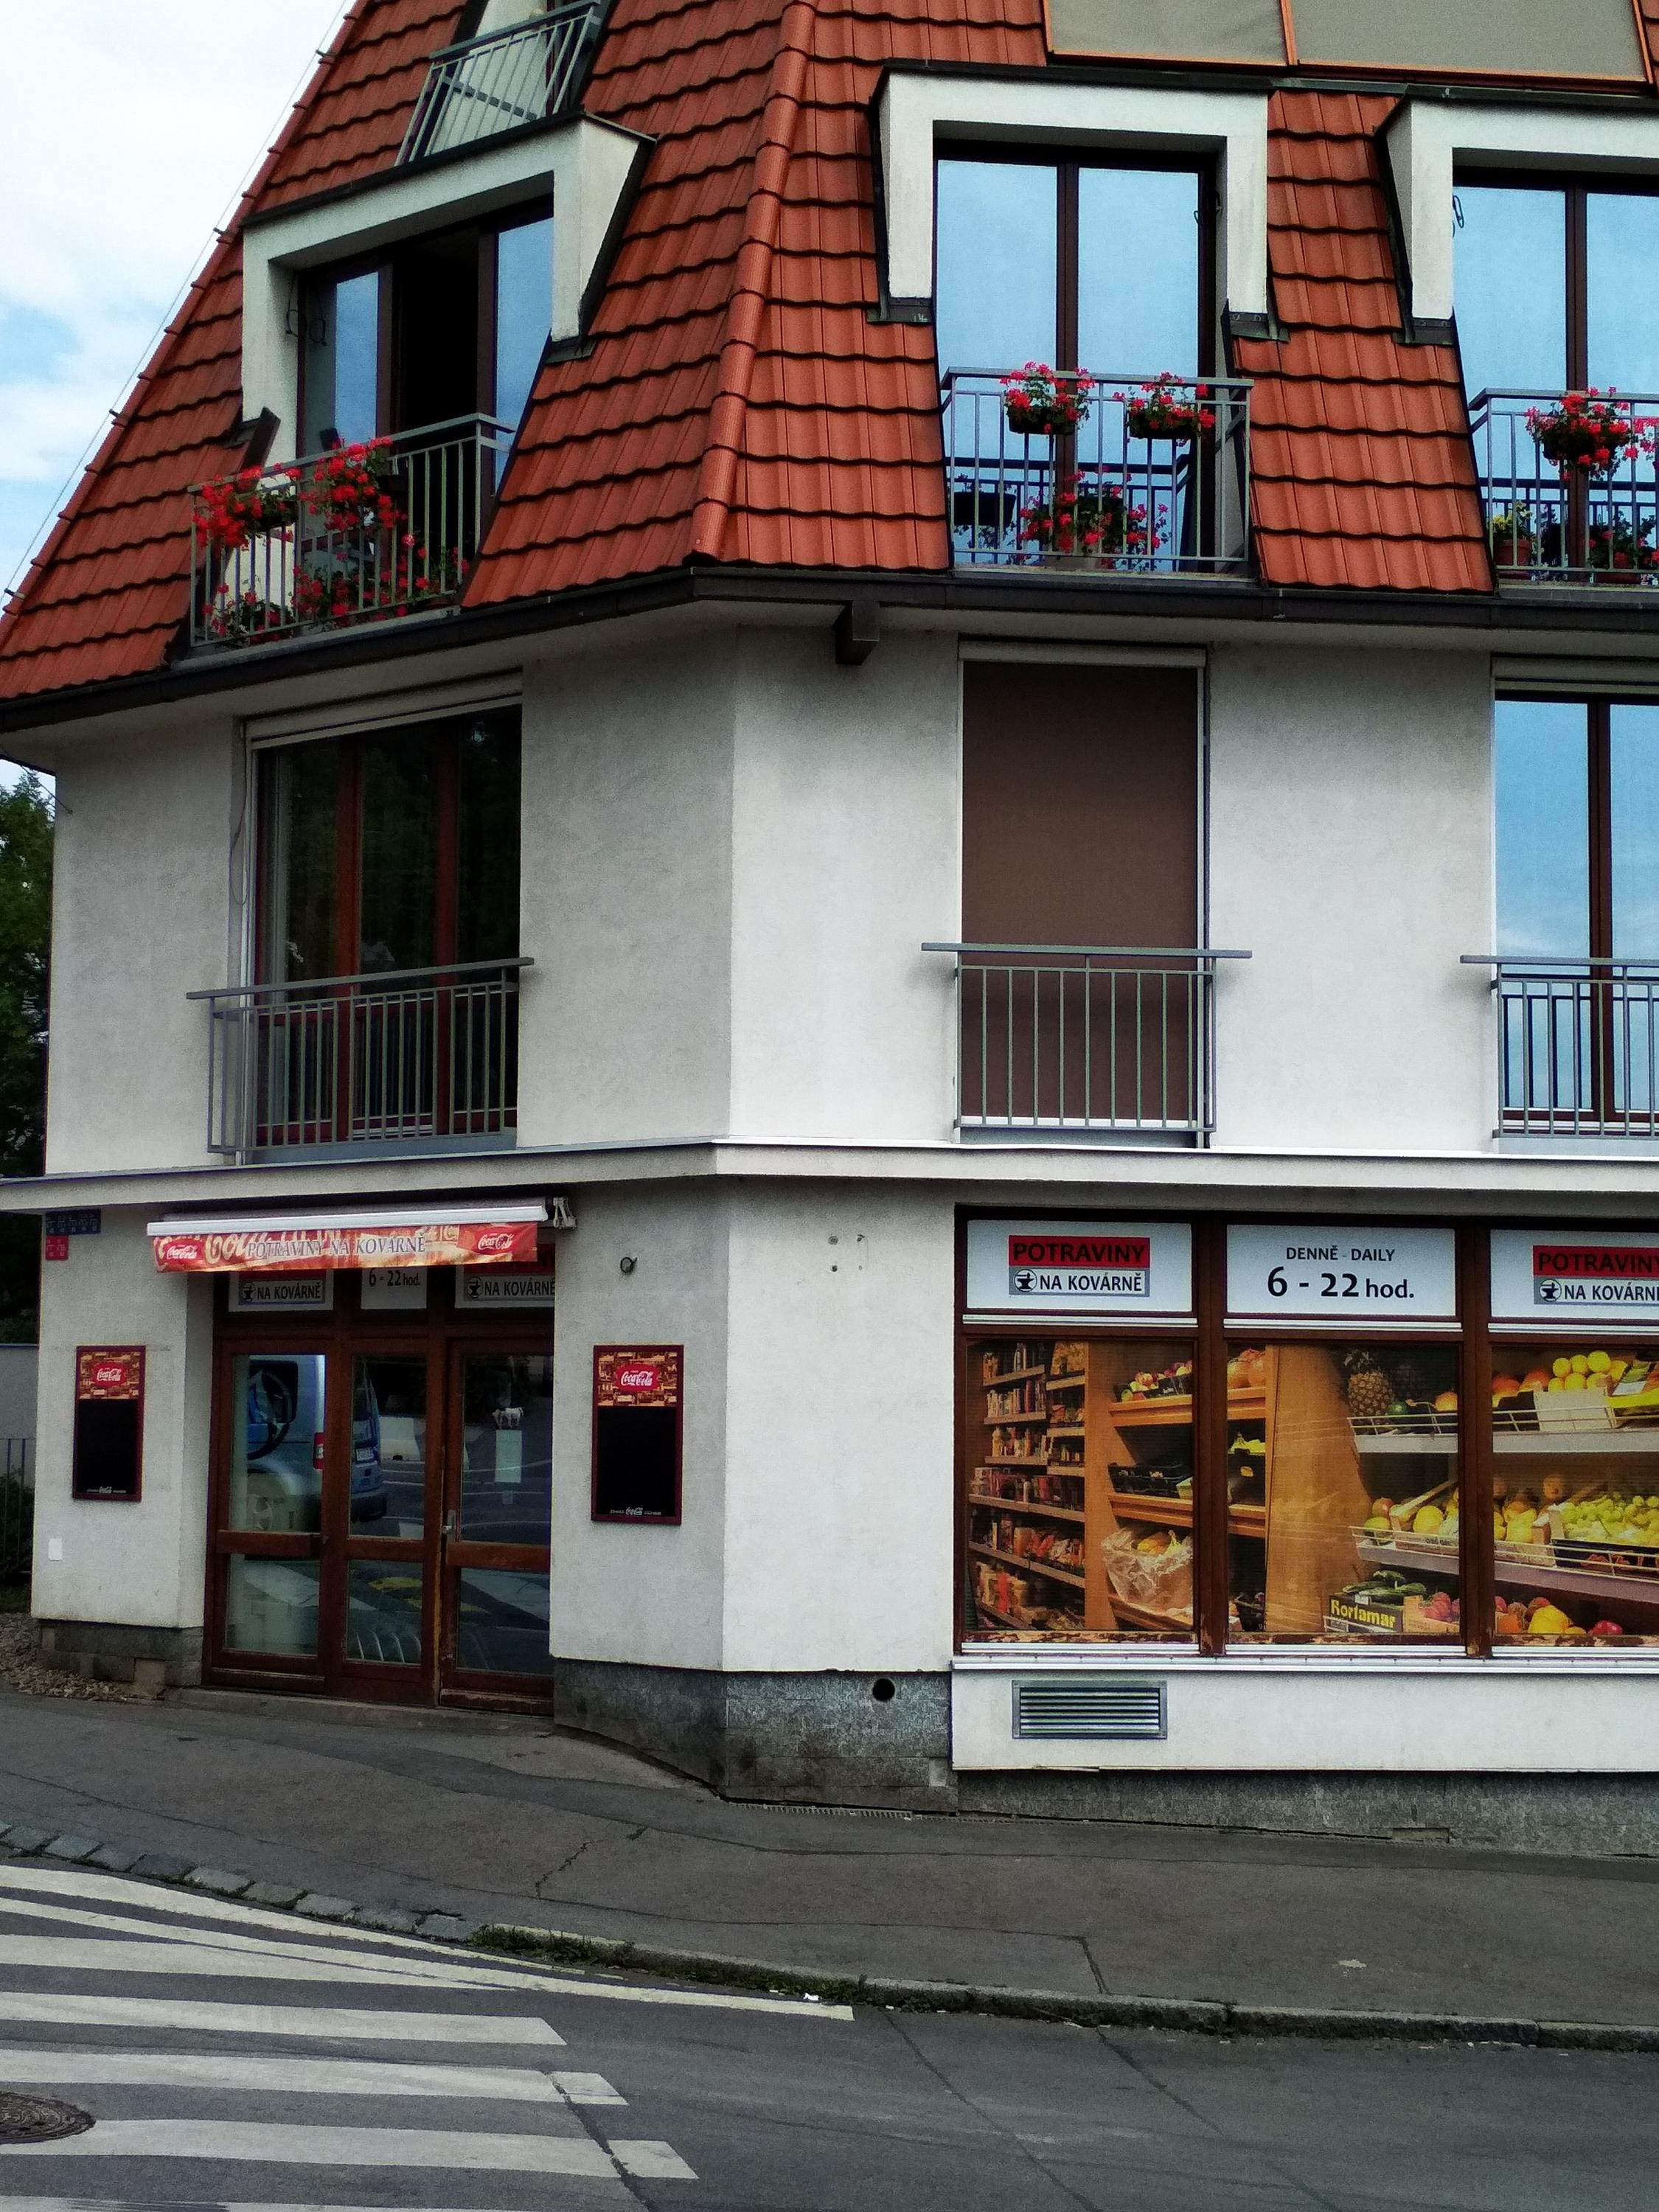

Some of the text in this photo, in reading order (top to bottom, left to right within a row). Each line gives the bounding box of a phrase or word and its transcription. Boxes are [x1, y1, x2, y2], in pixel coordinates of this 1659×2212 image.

[246, 1240, 325, 1260] POTRAVINY
[332, 1239, 350, 1256] NA
[1013, 1242, 1145, 1263] POTRAVINY
[1286, 1245, 1338, 1261] DENNĚ
[1351, 1248, 1396, 1262] DAILY
[369, 1268, 377, 1287] 6
[387, 1270, 401, 1287] 22
[403, 1273, 421, 1287] hod.
[1040, 1272, 1143, 1291] NA KOVÁRNĚ
[1267, 1266, 1288, 1297] 6
[1321, 1273, 1360, 1297] 22
[1366, 1278, 1415, 1298] hod.
[257, 1281, 321, 1300] NA KOVÁRNĚ
[484, 1281, 500, 1295] NA
[1564, 1282, 1659, 1301] NA KOVÁRN
